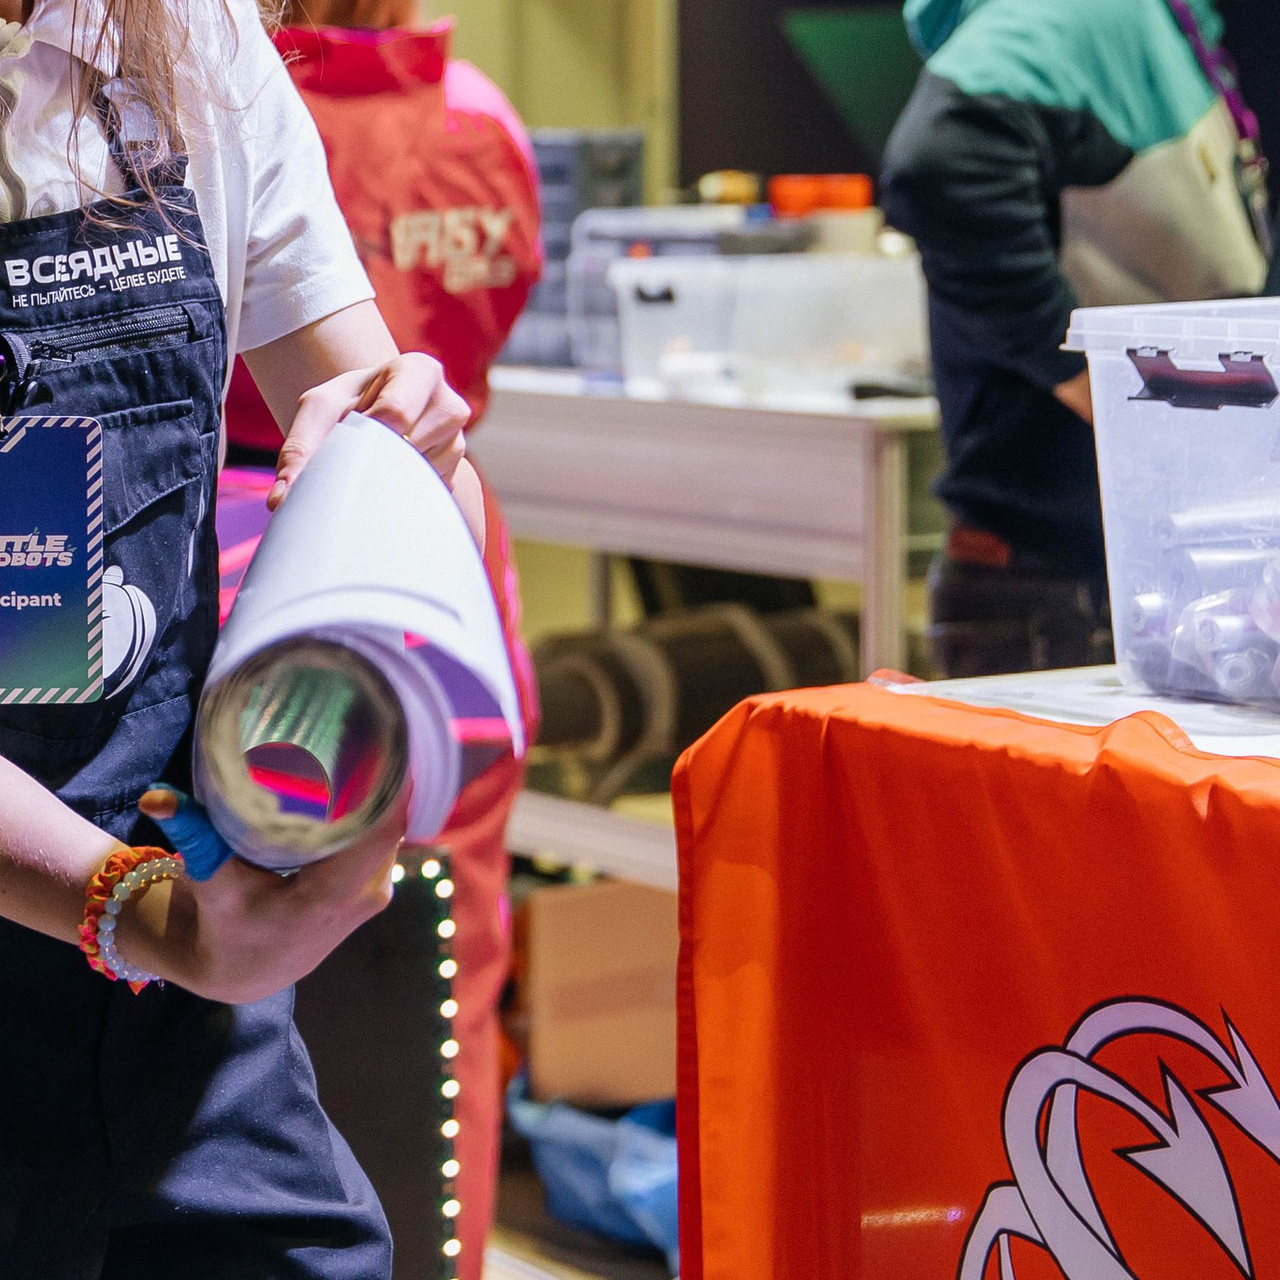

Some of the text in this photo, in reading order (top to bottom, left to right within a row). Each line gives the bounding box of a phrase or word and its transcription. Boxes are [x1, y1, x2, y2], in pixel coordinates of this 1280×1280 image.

[5, 234, 182, 287] ВСЕЯДНЫЕ
[12, 294, 29, 308] НЕ
[30, 284, 96, 306] ПЫТАЙТЕСЬ
[109, 273, 147, 291] ЦЕЛЕЕ
[146, 266, 187, 284] БУДЕТЕ
